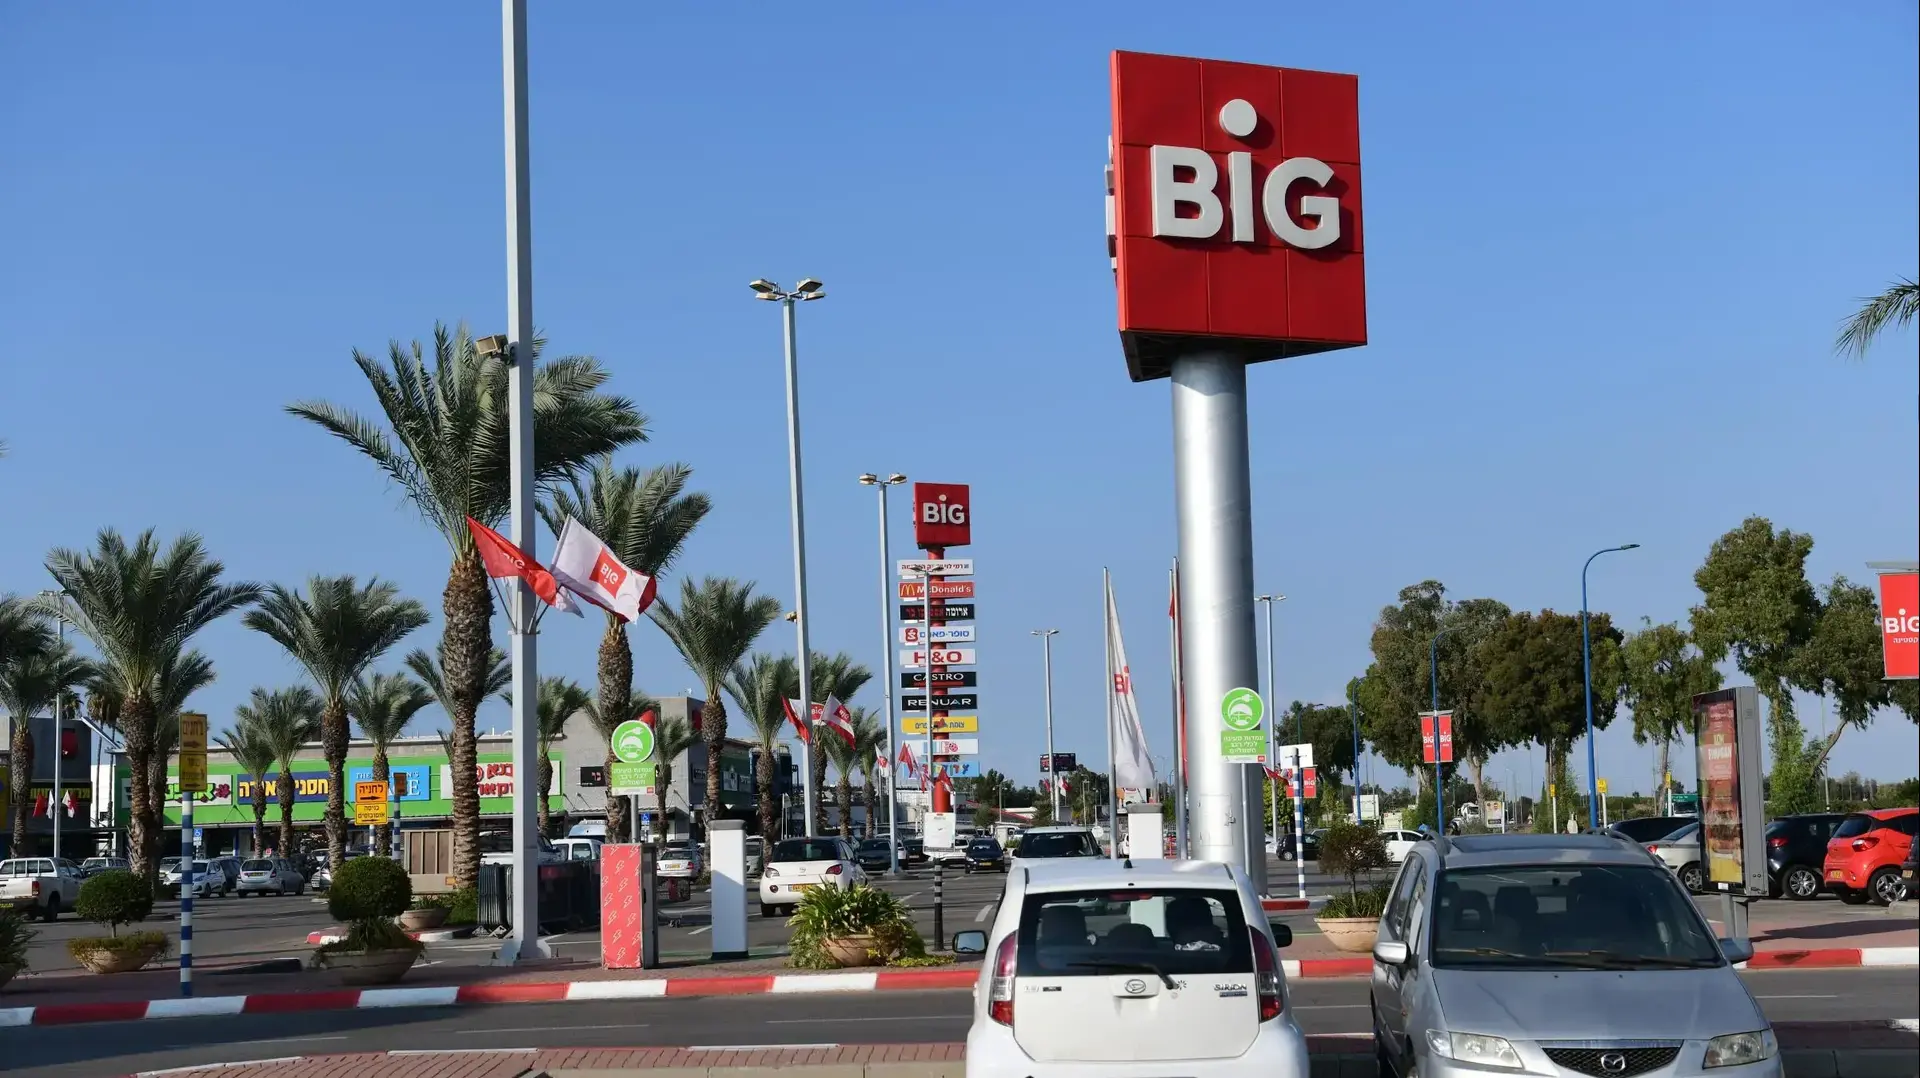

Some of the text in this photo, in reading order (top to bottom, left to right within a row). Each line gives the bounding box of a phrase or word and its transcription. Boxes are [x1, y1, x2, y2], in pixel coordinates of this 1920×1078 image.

[945, 607, 968, 616] ארומה
[913, 651, 962, 664] H&O
[294, 778, 329, 795] חסני
[359, 784, 384, 794] לחניה
